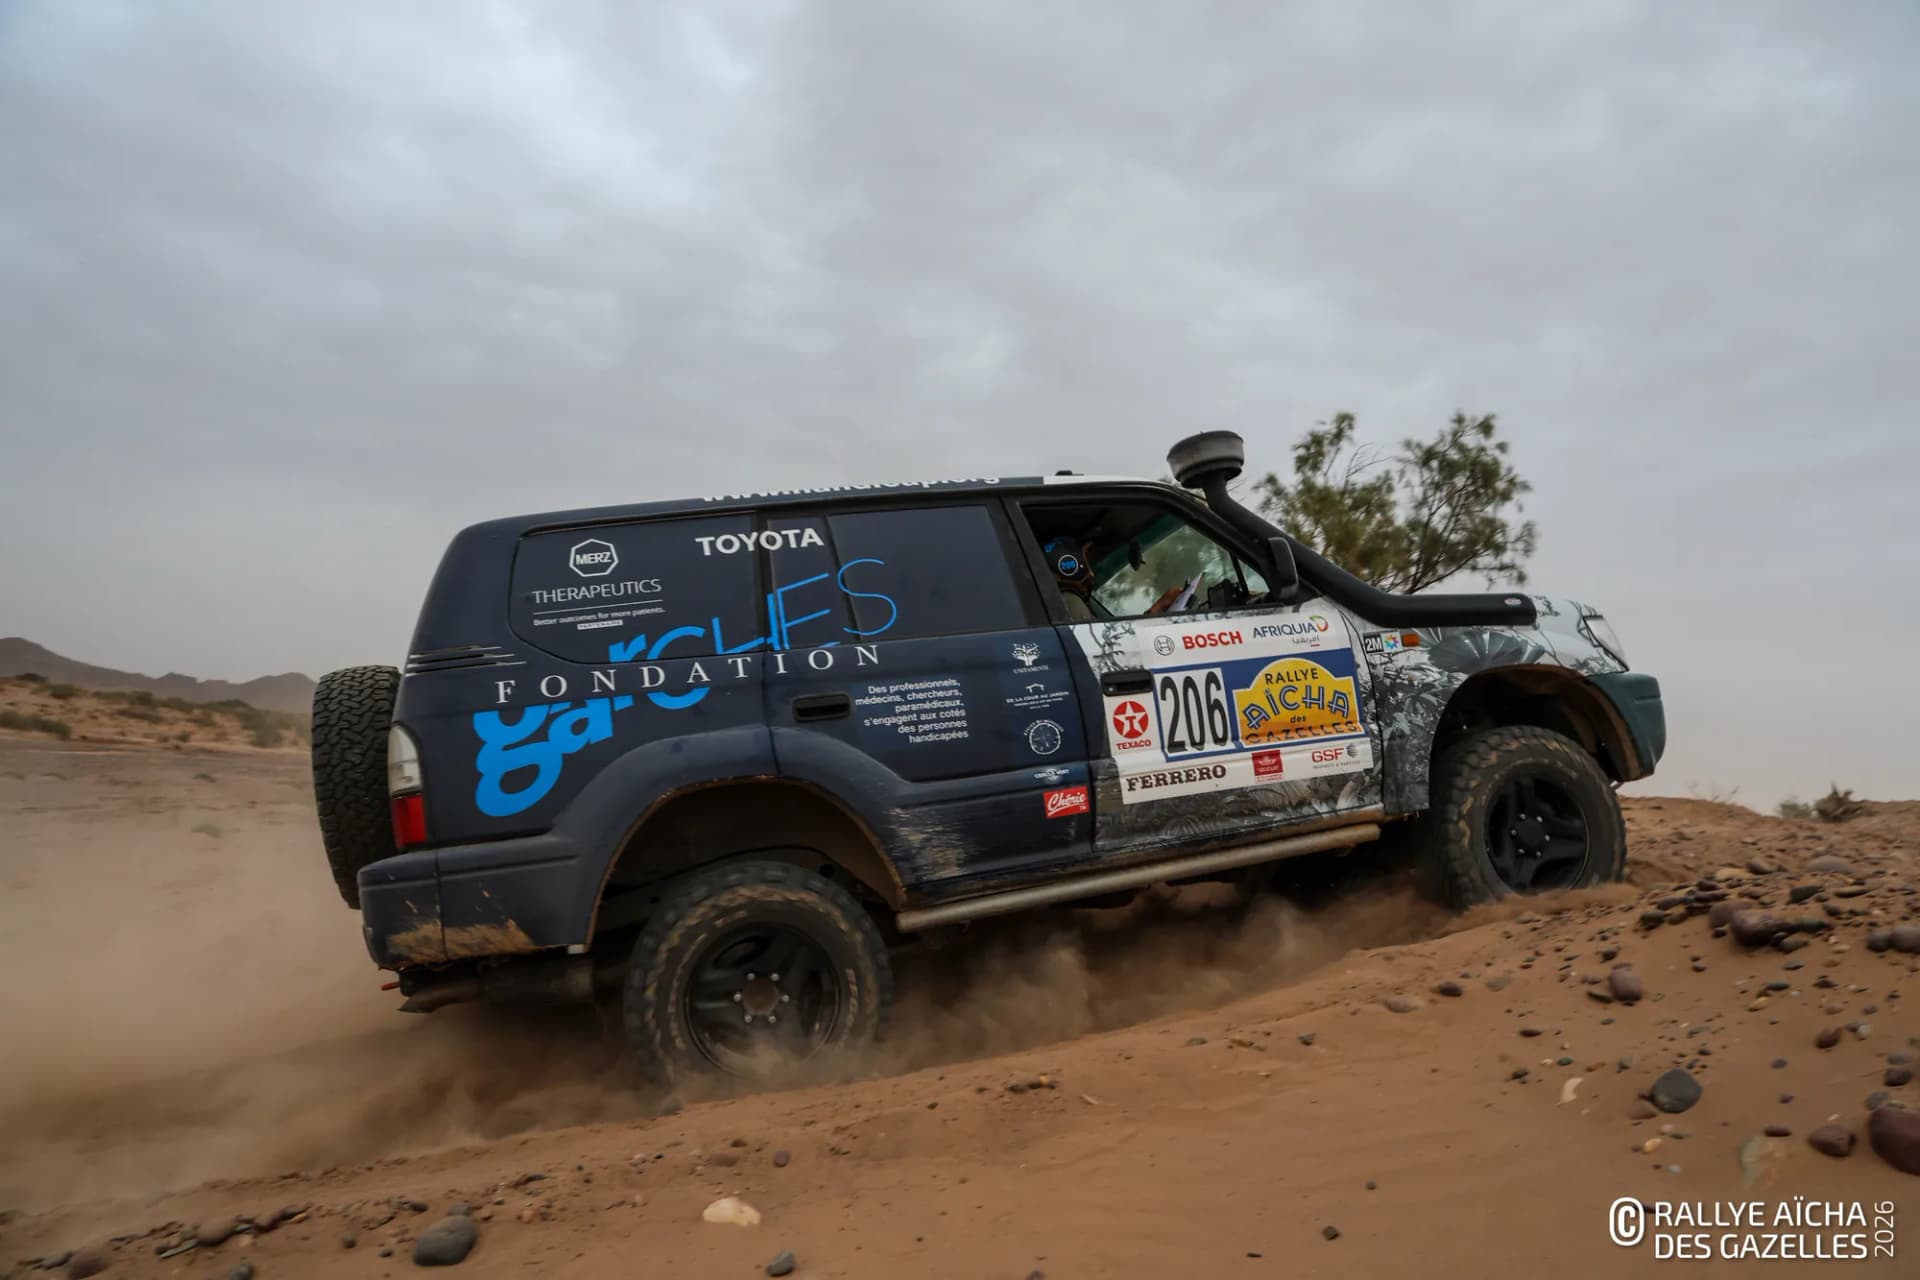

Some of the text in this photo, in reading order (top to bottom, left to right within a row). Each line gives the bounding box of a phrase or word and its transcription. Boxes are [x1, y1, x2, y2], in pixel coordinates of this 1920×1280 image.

[695, 527, 824, 556] TOYOTA
[575, 551, 612, 565] MERZ
[532, 578, 662, 603] THERAPEUTICS
[610, 610, 631, 618] more
[1252, 621, 1318, 639] AFRIQUIA
[1181, 630, 1243, 650] BOSCH
[1365, 636, 1383, 651] 2M
[495, 644, 880, 703] FONDATION
[1265, 668, 1319, 685] RALLYE
[868, 678, 960, 694] Des professionnels,
[855, 688, 962, 706] médecins, chercheurs,
[895, 699, 964, 713] paramédicaux,
[1160, 671, 1229, 754] 206
[1243, 685, 1350, 729] AÏCHA
[864, 713, 918, 726] s'engagent
[920, 711, 937, 720] aux
[898, 719, 967, 734] des personnes
[1290, 715, 1306, 723] des
[909, 730, 969, 743] handicapées
[1116, 739, 1152, 750] TEXACO
[1311, 747, 1344, 763] GSF
[1126, 764, 1227, 792] FERRERO
